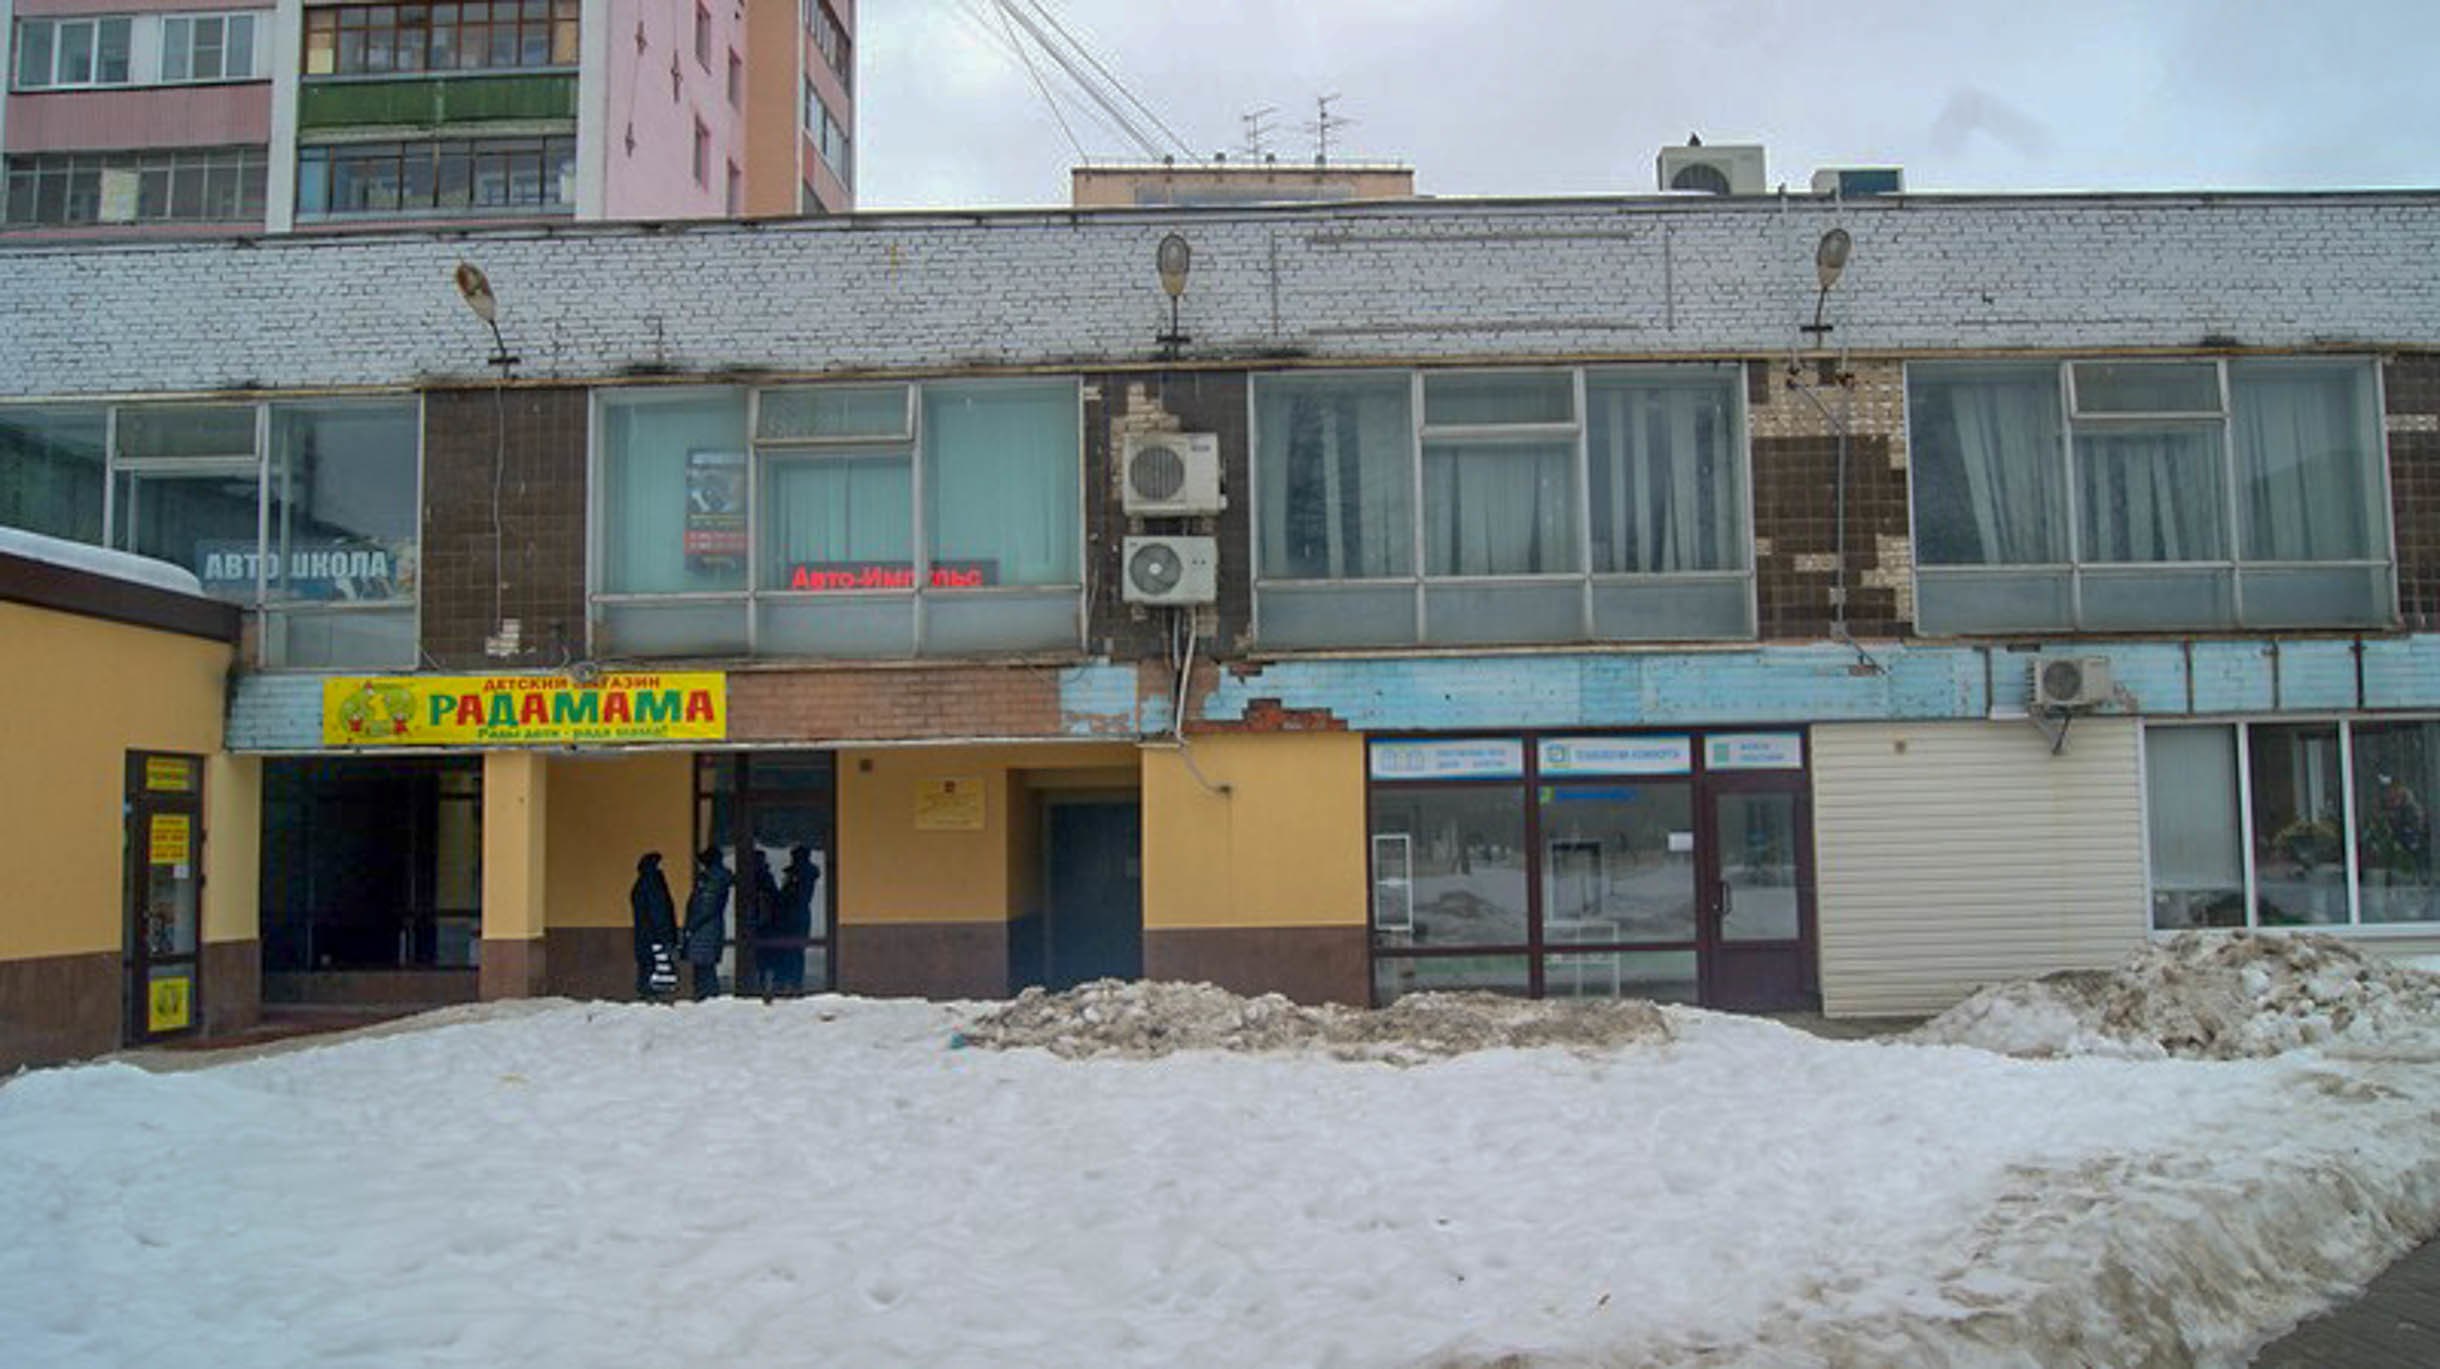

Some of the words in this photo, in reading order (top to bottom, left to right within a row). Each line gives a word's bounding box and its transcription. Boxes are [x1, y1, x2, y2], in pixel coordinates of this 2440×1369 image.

[791, 564, 984, 589] Авто-Импльс
[483, 676, 568, 692] ДЕТСКИЙ
[428, 689, 715, 727] РАДАМАМА
